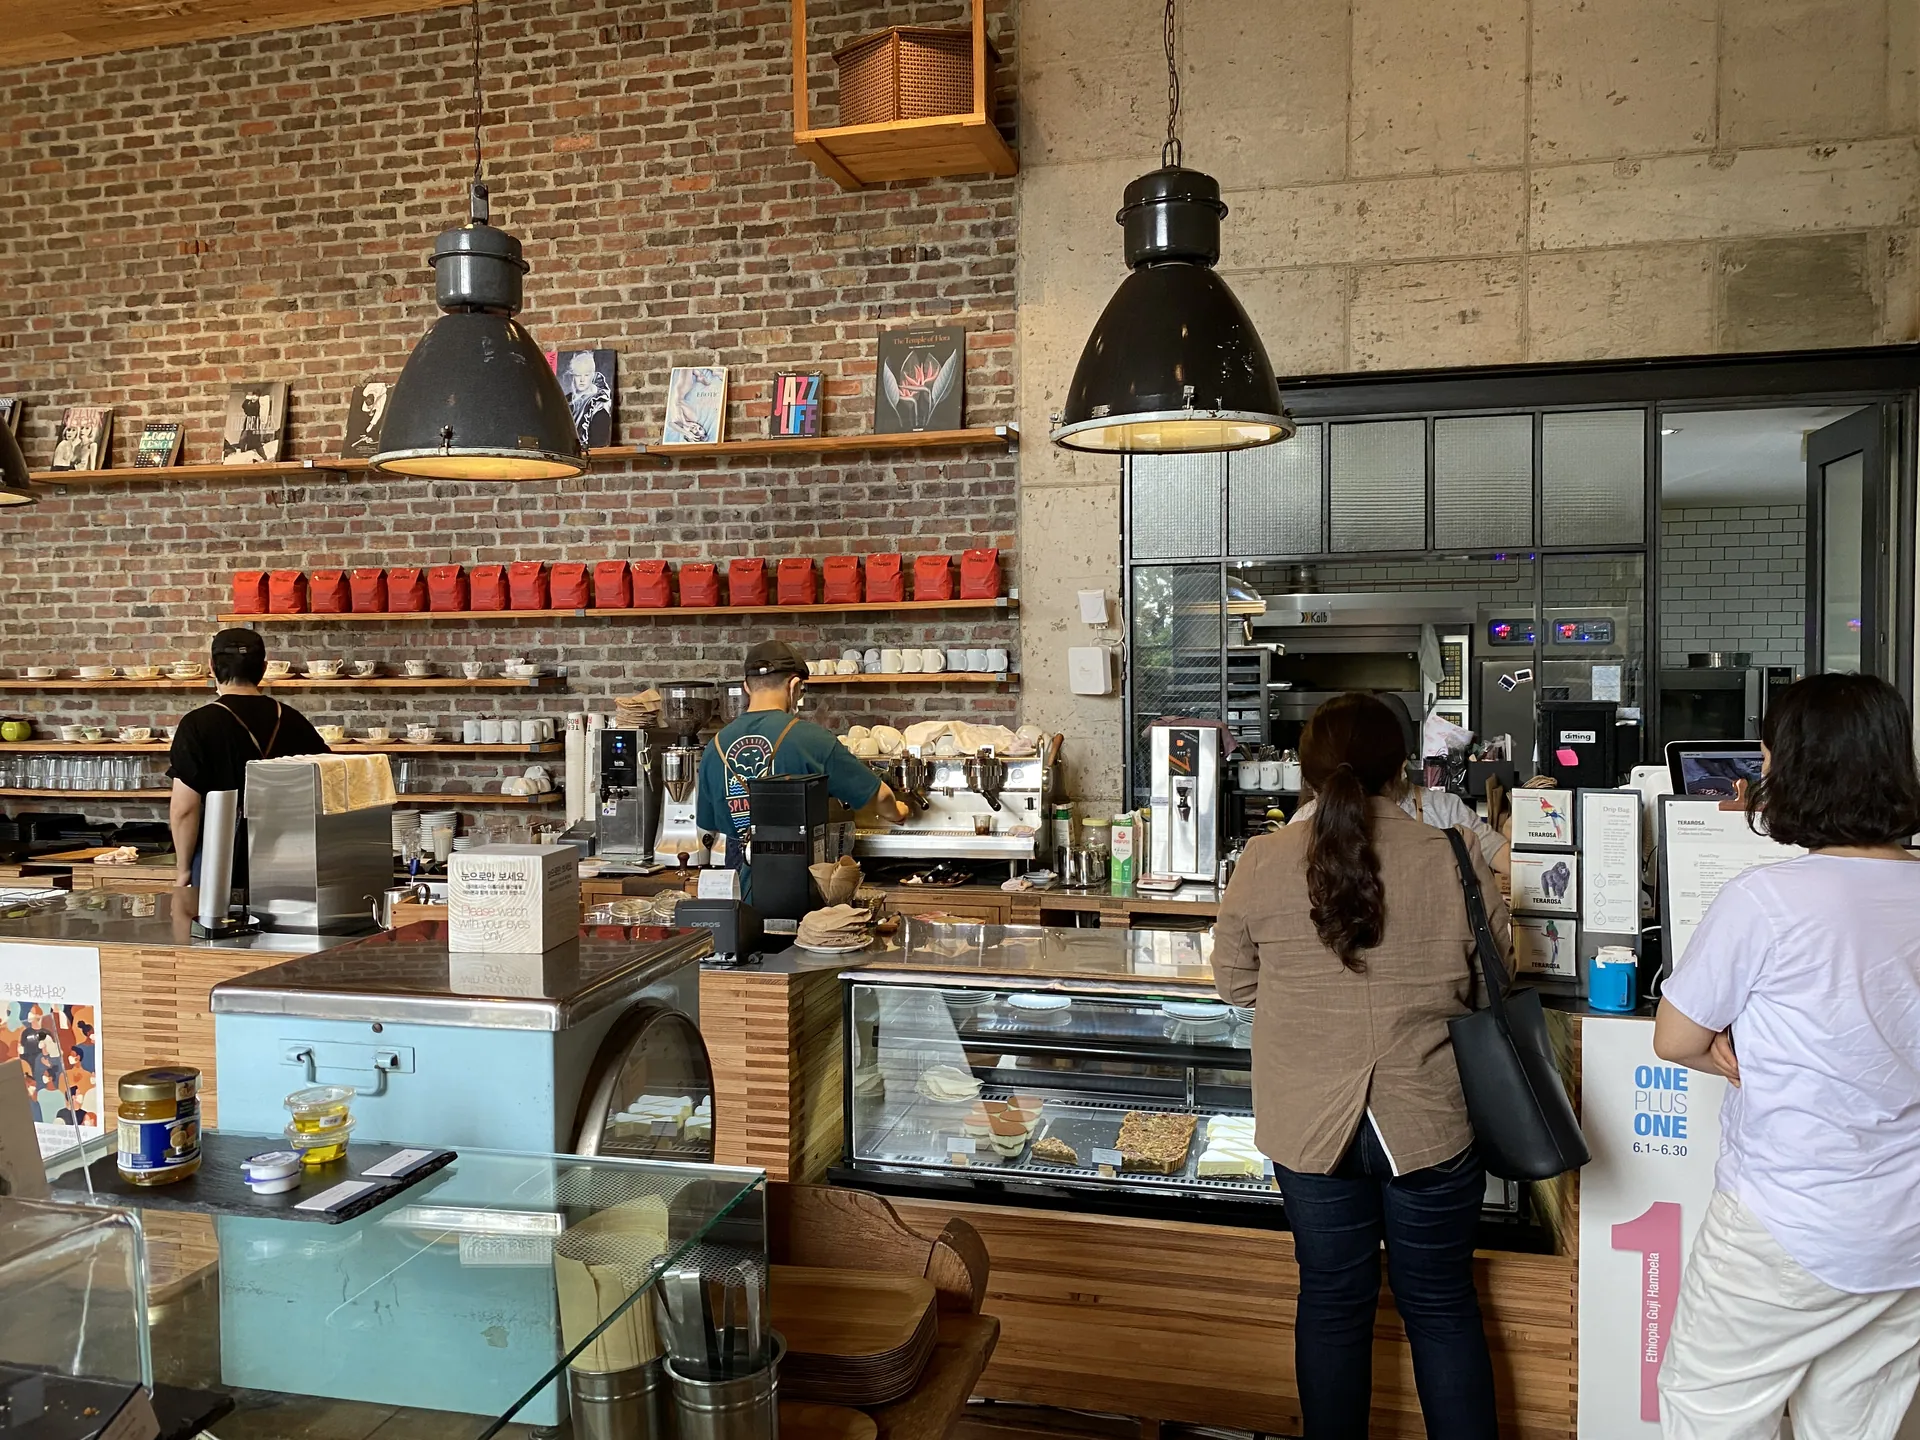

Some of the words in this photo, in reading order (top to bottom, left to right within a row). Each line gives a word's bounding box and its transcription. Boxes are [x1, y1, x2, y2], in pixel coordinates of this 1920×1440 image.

[904, 336, 926, 345] Temple
[774, 377, 819, 416] JAZZ
[780, 406, 817, 434] LIFE
[143, 432, 176, 440] LOGO
[1311, 612, 1327, 623] Kolb
[1565, 733, 1591, 741] ditting
[461, 872, 495, 881] 눈으로만
[498, 872, 527, 881] 보세요.
[461, 904, 495, 917] Please
[496, 907, 528, 917] watch
[459, 918, 478, 928] with
[480, 920, 503, 931] your
[506, 921, 531, 931] eyes
[4, 982, 66, 999] 착용하셨나요?
[1634, 1065, 1688, 1091] ONE
[1635, 1091, 1688, 1114] PLUS
[1634, 1113, 1687, 1139] ONE
[1633, 1142, 1688, 1156] 6.1~6.30
[1647, 1252, 1660, 1298] Hambela
[1646, 1301, 1661, 1320] Guji
[1646, 1323, 1660, 1363] Ethiopia
